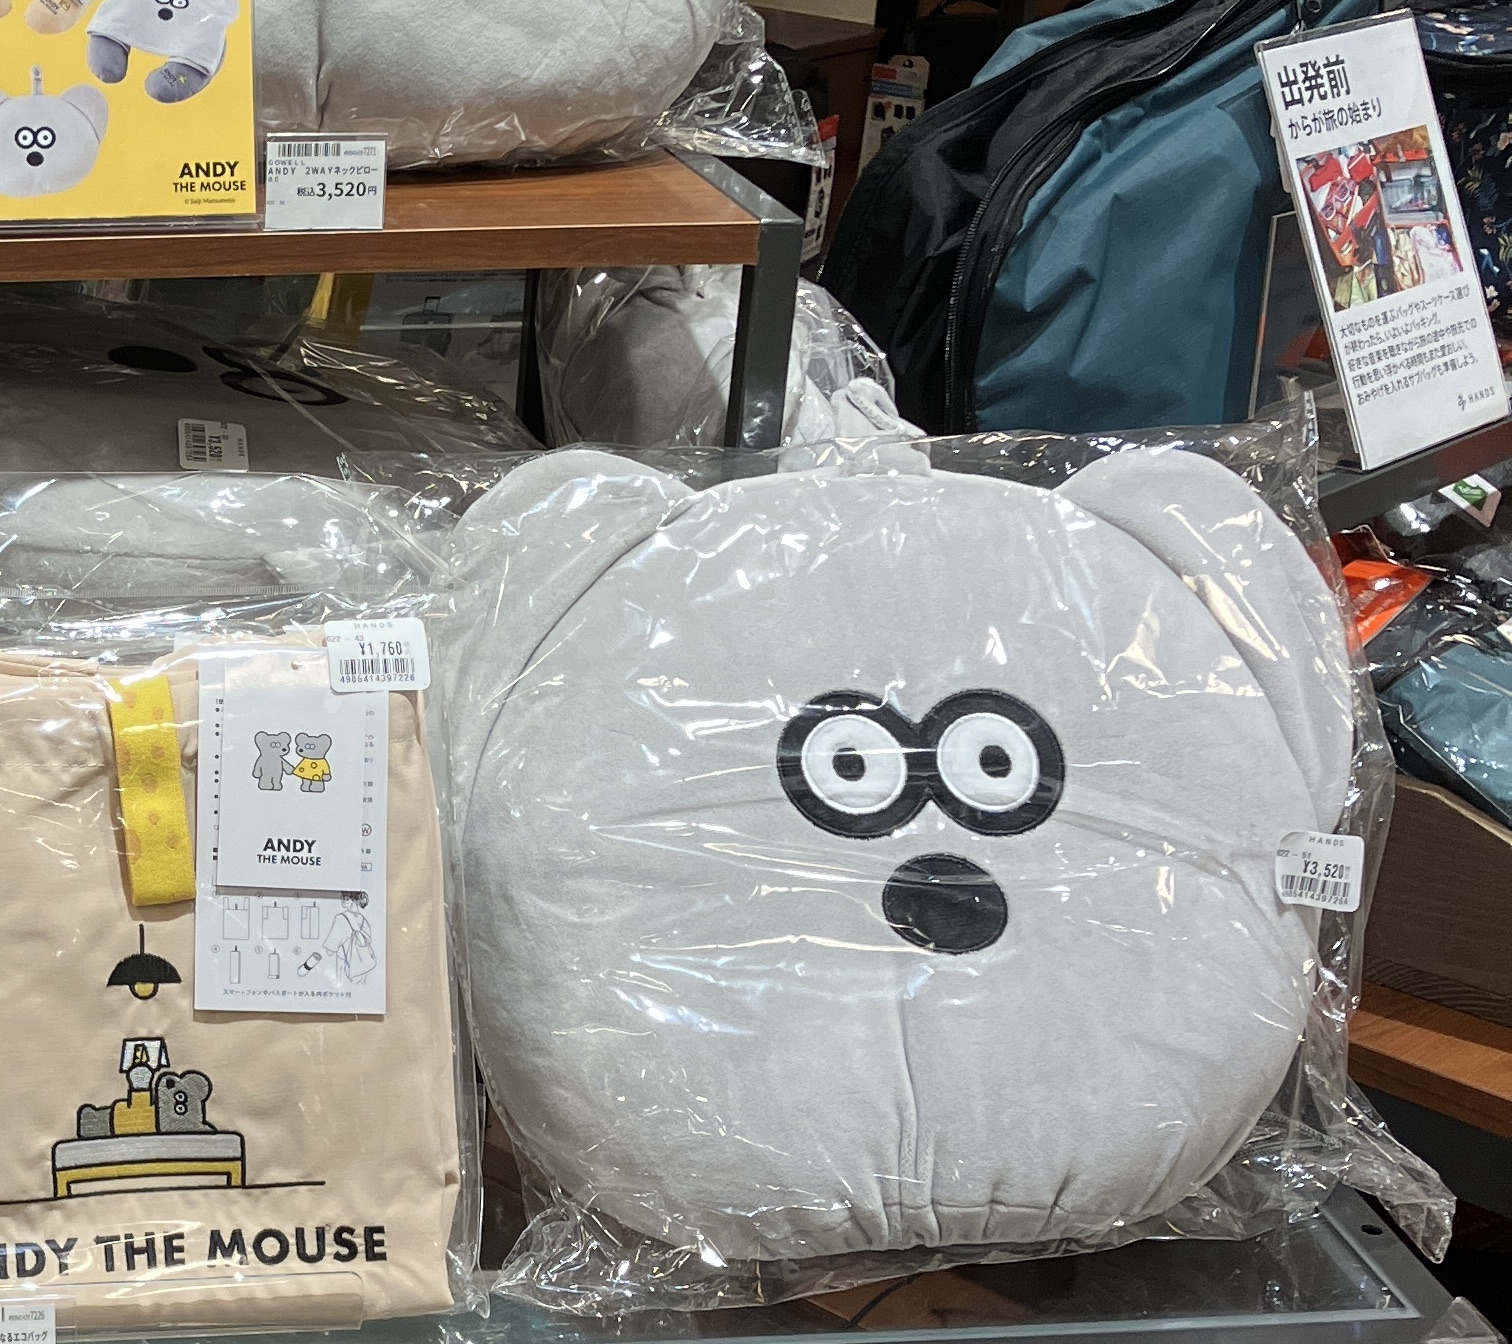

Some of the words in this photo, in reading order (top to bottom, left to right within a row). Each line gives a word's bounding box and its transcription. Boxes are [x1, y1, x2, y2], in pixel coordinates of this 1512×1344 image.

[1278, 54, 1350, 110] 出発前
[1288, 97, 1381, 139] からが旅の始まり
[179, 161, 239, 178] ANDY
[268, 167, 296, 175] ANDY
[306, 166, 378, 176] 2WAYネックピロー
[173, 182, 196, 193] THE
[200, 181, 246, 192] MOUSE
[1468, 387, 1495, 403] HANDS
[359, 642, 402, 658] ¥1,760
[263, 838, 316, 853] ANDY
[1309, 837, 1344, 846] HANDS
[257, 854, 277, 864] THE
[280, 855, 321, 866] MOUSE
[1303, 860, 1344, 879] ¥3,520
[94, 1230, 186, 1273] THE
[207, 1225, 387, 1268] MOUSE
